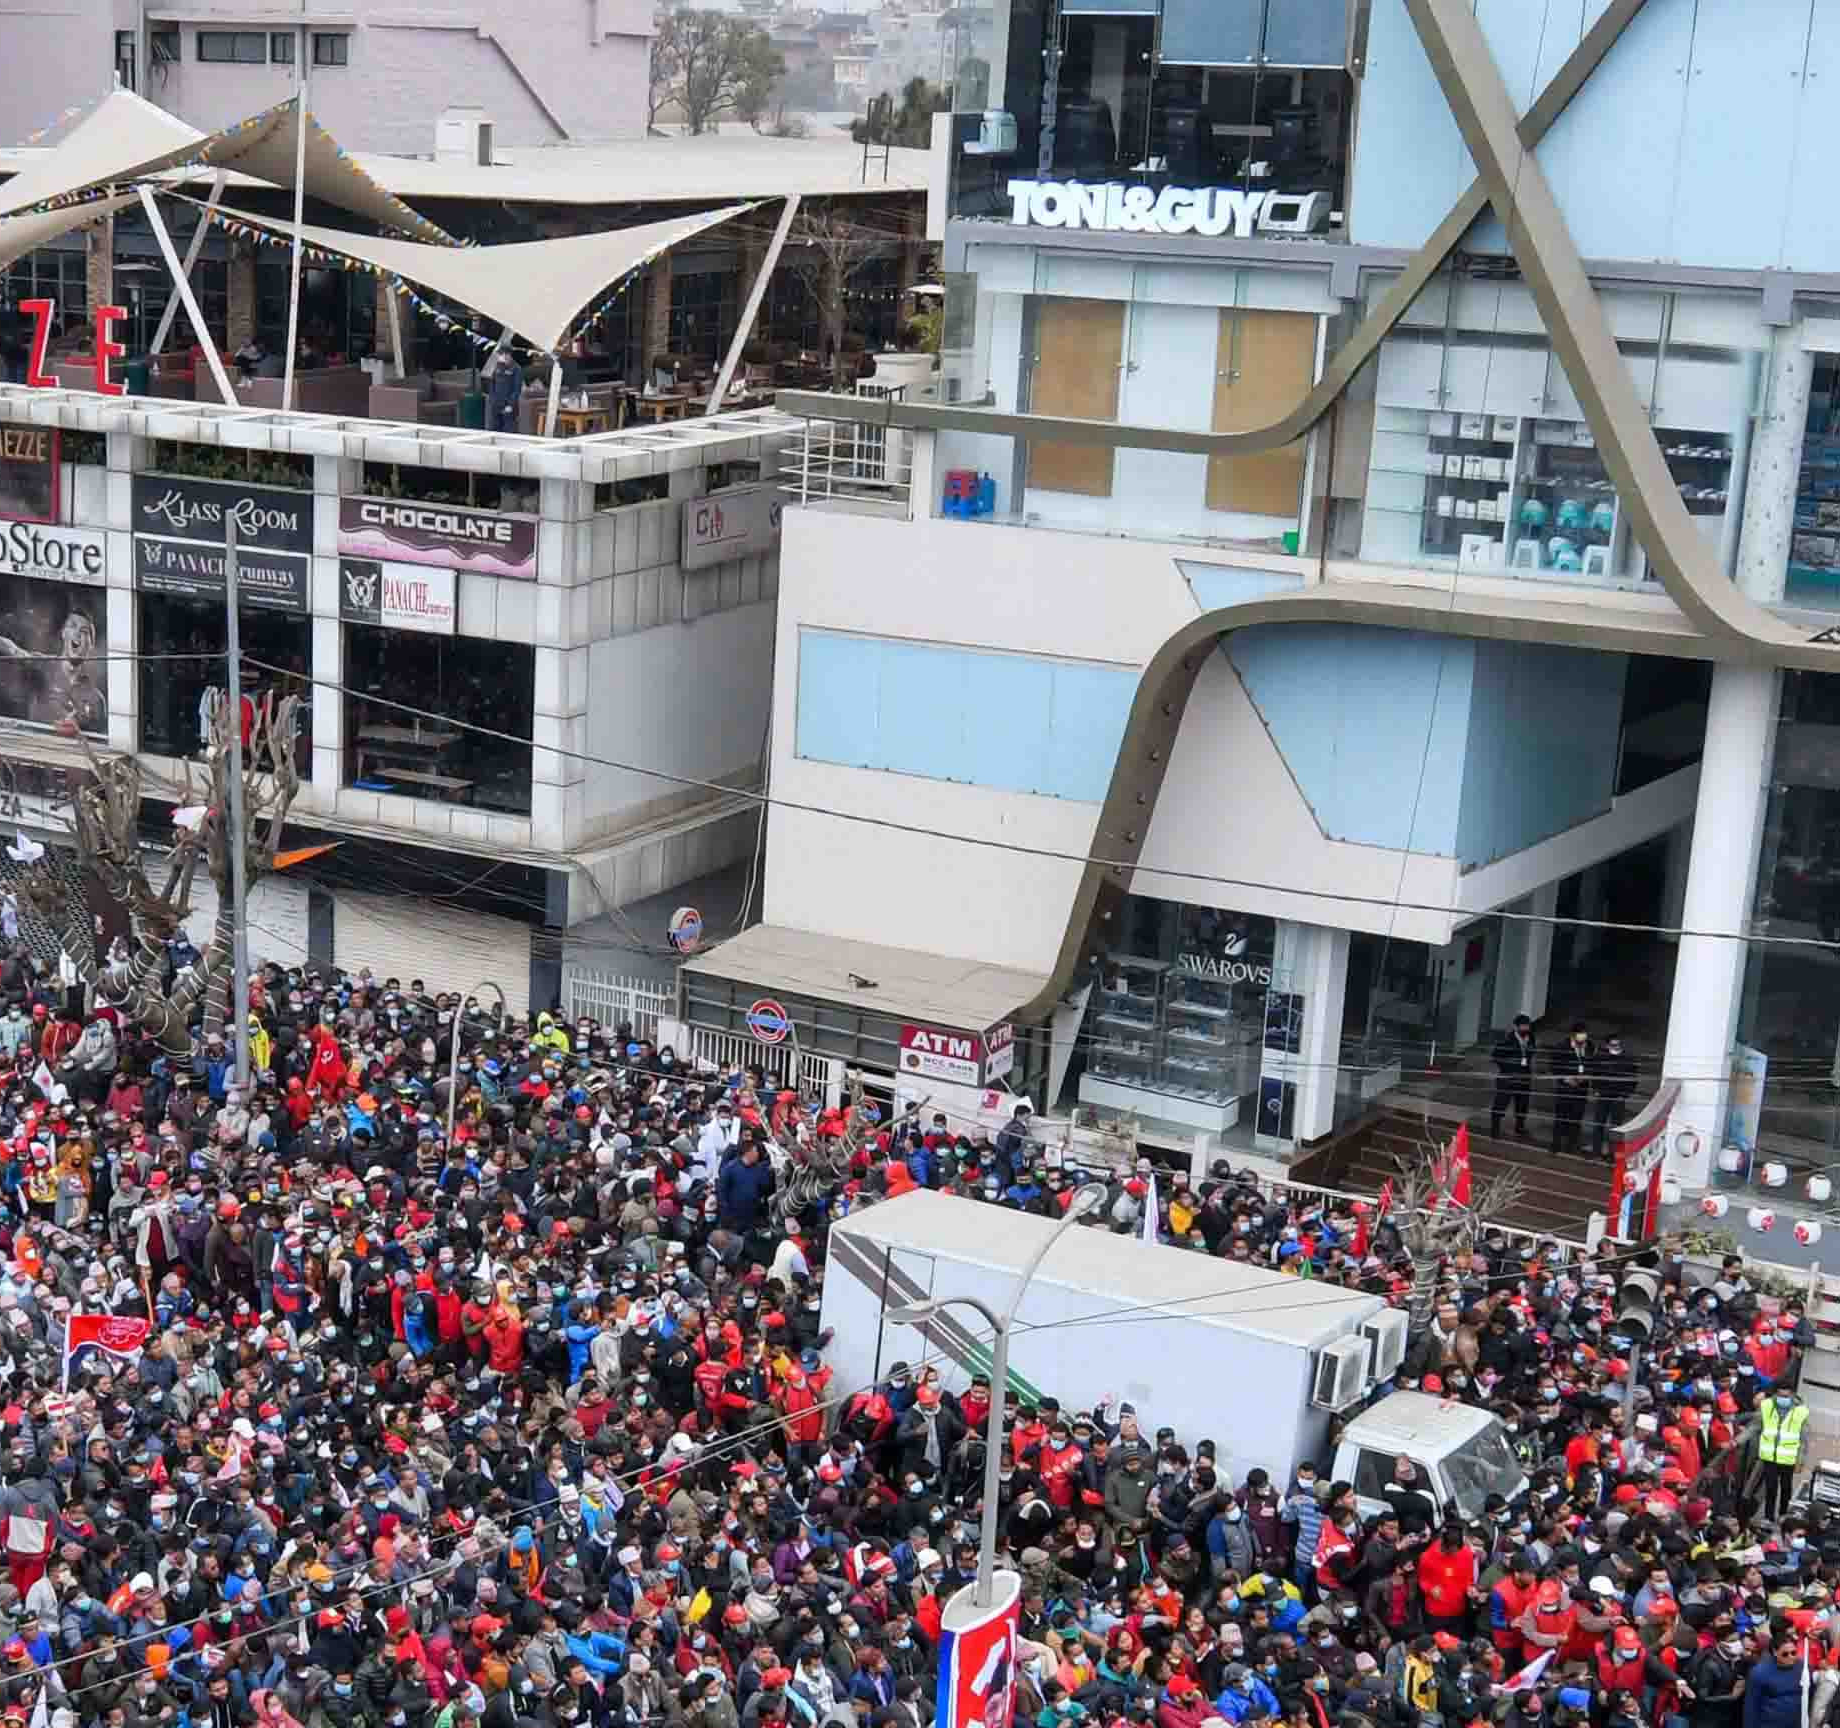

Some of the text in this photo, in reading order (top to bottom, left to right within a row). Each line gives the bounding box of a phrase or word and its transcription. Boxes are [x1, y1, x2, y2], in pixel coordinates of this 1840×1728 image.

[1007, 179, 1262, 238] TONI&GUY
[143, 489, 222, 529] KLASS
[360, 503, 513, 542] CHOCOLATE
[166, 551, 227, 576] PANACH
[239, 565, 295, 587] runway
[384, 577, 429, 613] PANACHE
[911, 1031, 972, 1059] ATM
[990, 1024, 1013, 1050] ATM
